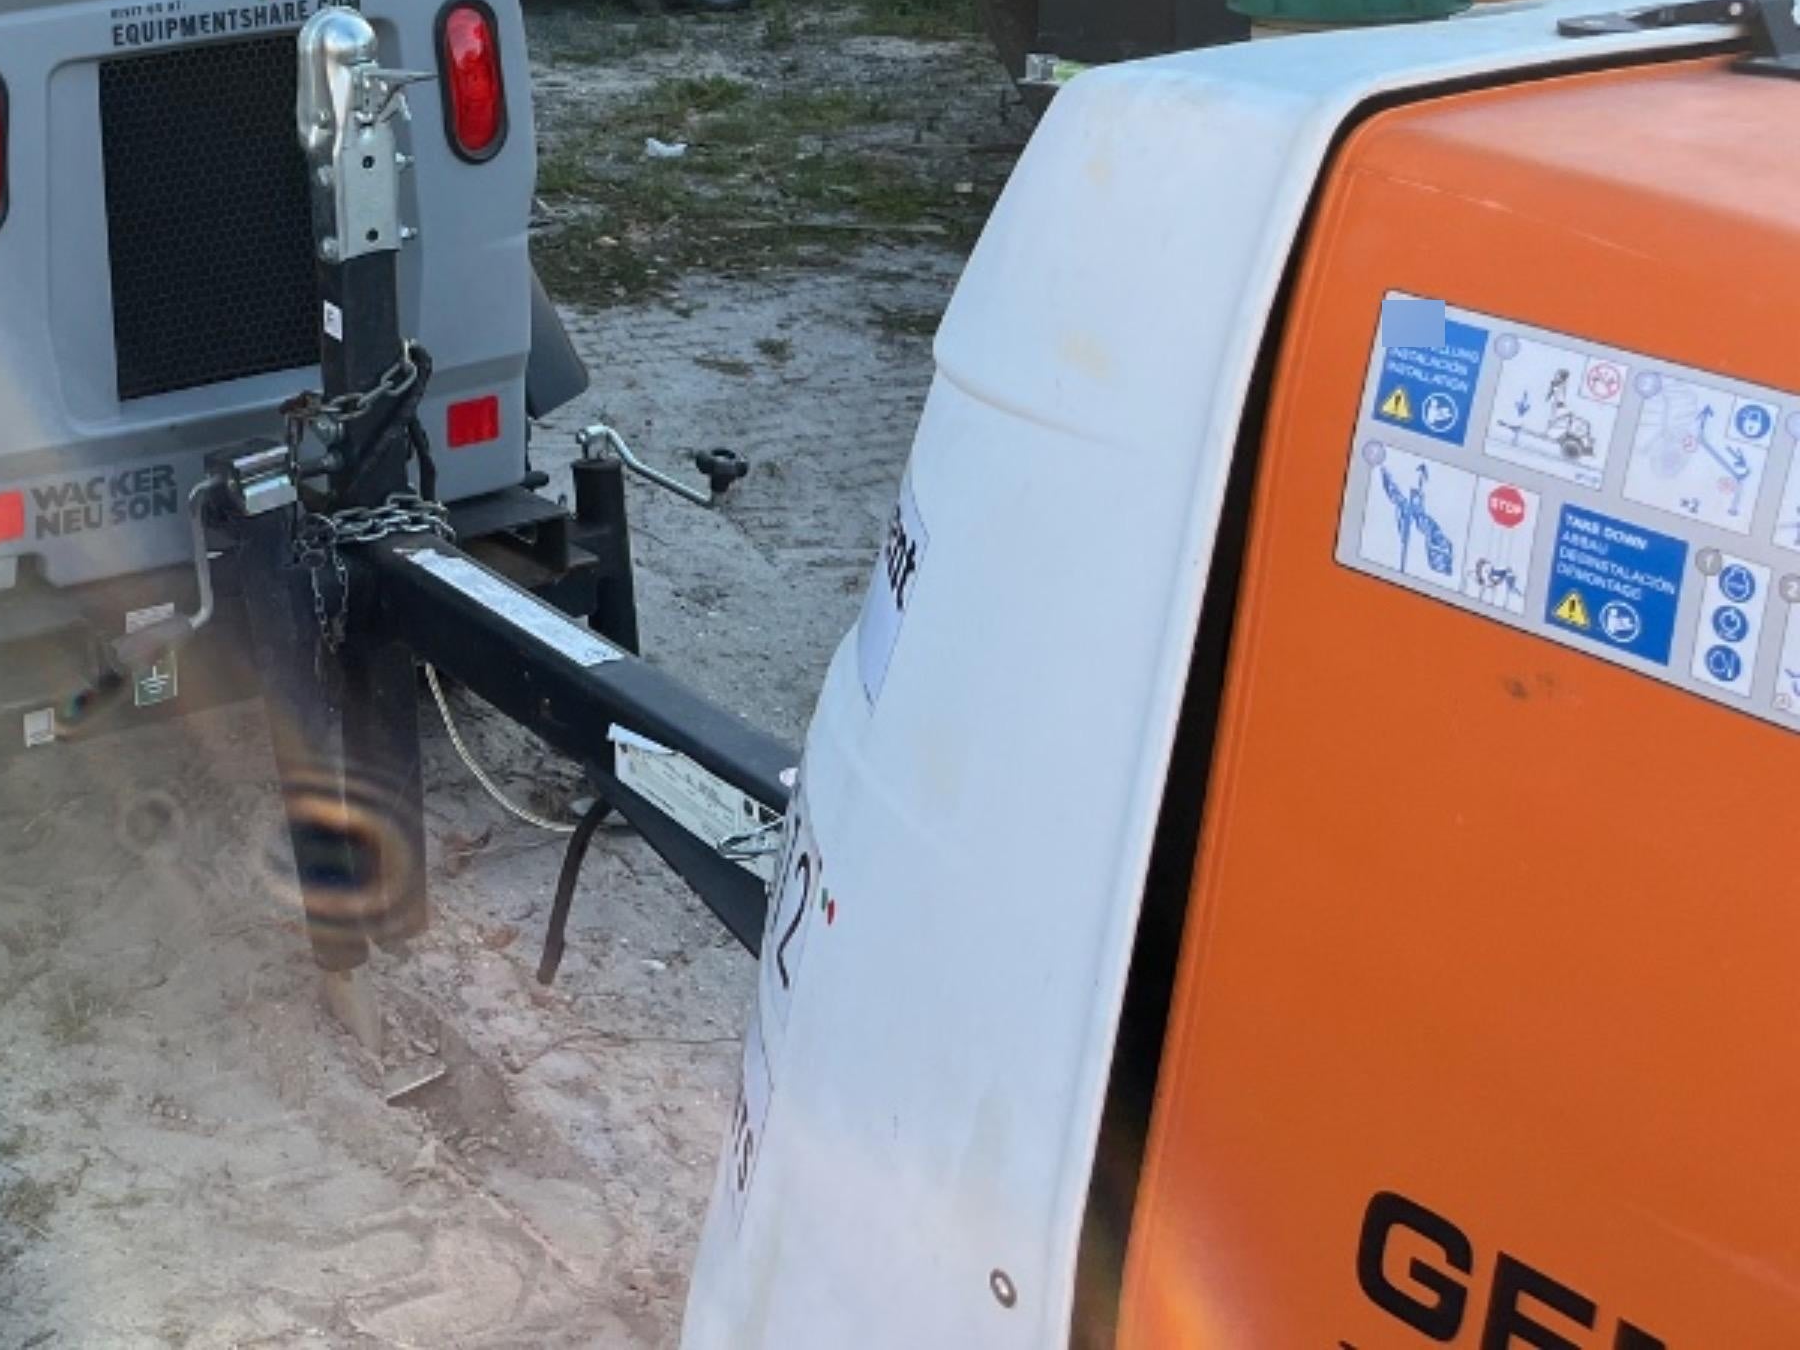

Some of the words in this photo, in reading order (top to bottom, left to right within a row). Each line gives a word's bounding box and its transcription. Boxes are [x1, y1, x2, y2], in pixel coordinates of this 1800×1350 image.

[30, 464, 177, 511] WACKER
[34, 490, 178, 540] NEUSON
[1604, 526, 1648, 551] DOWN
[1356, 1188, 1668, 1350] GE
